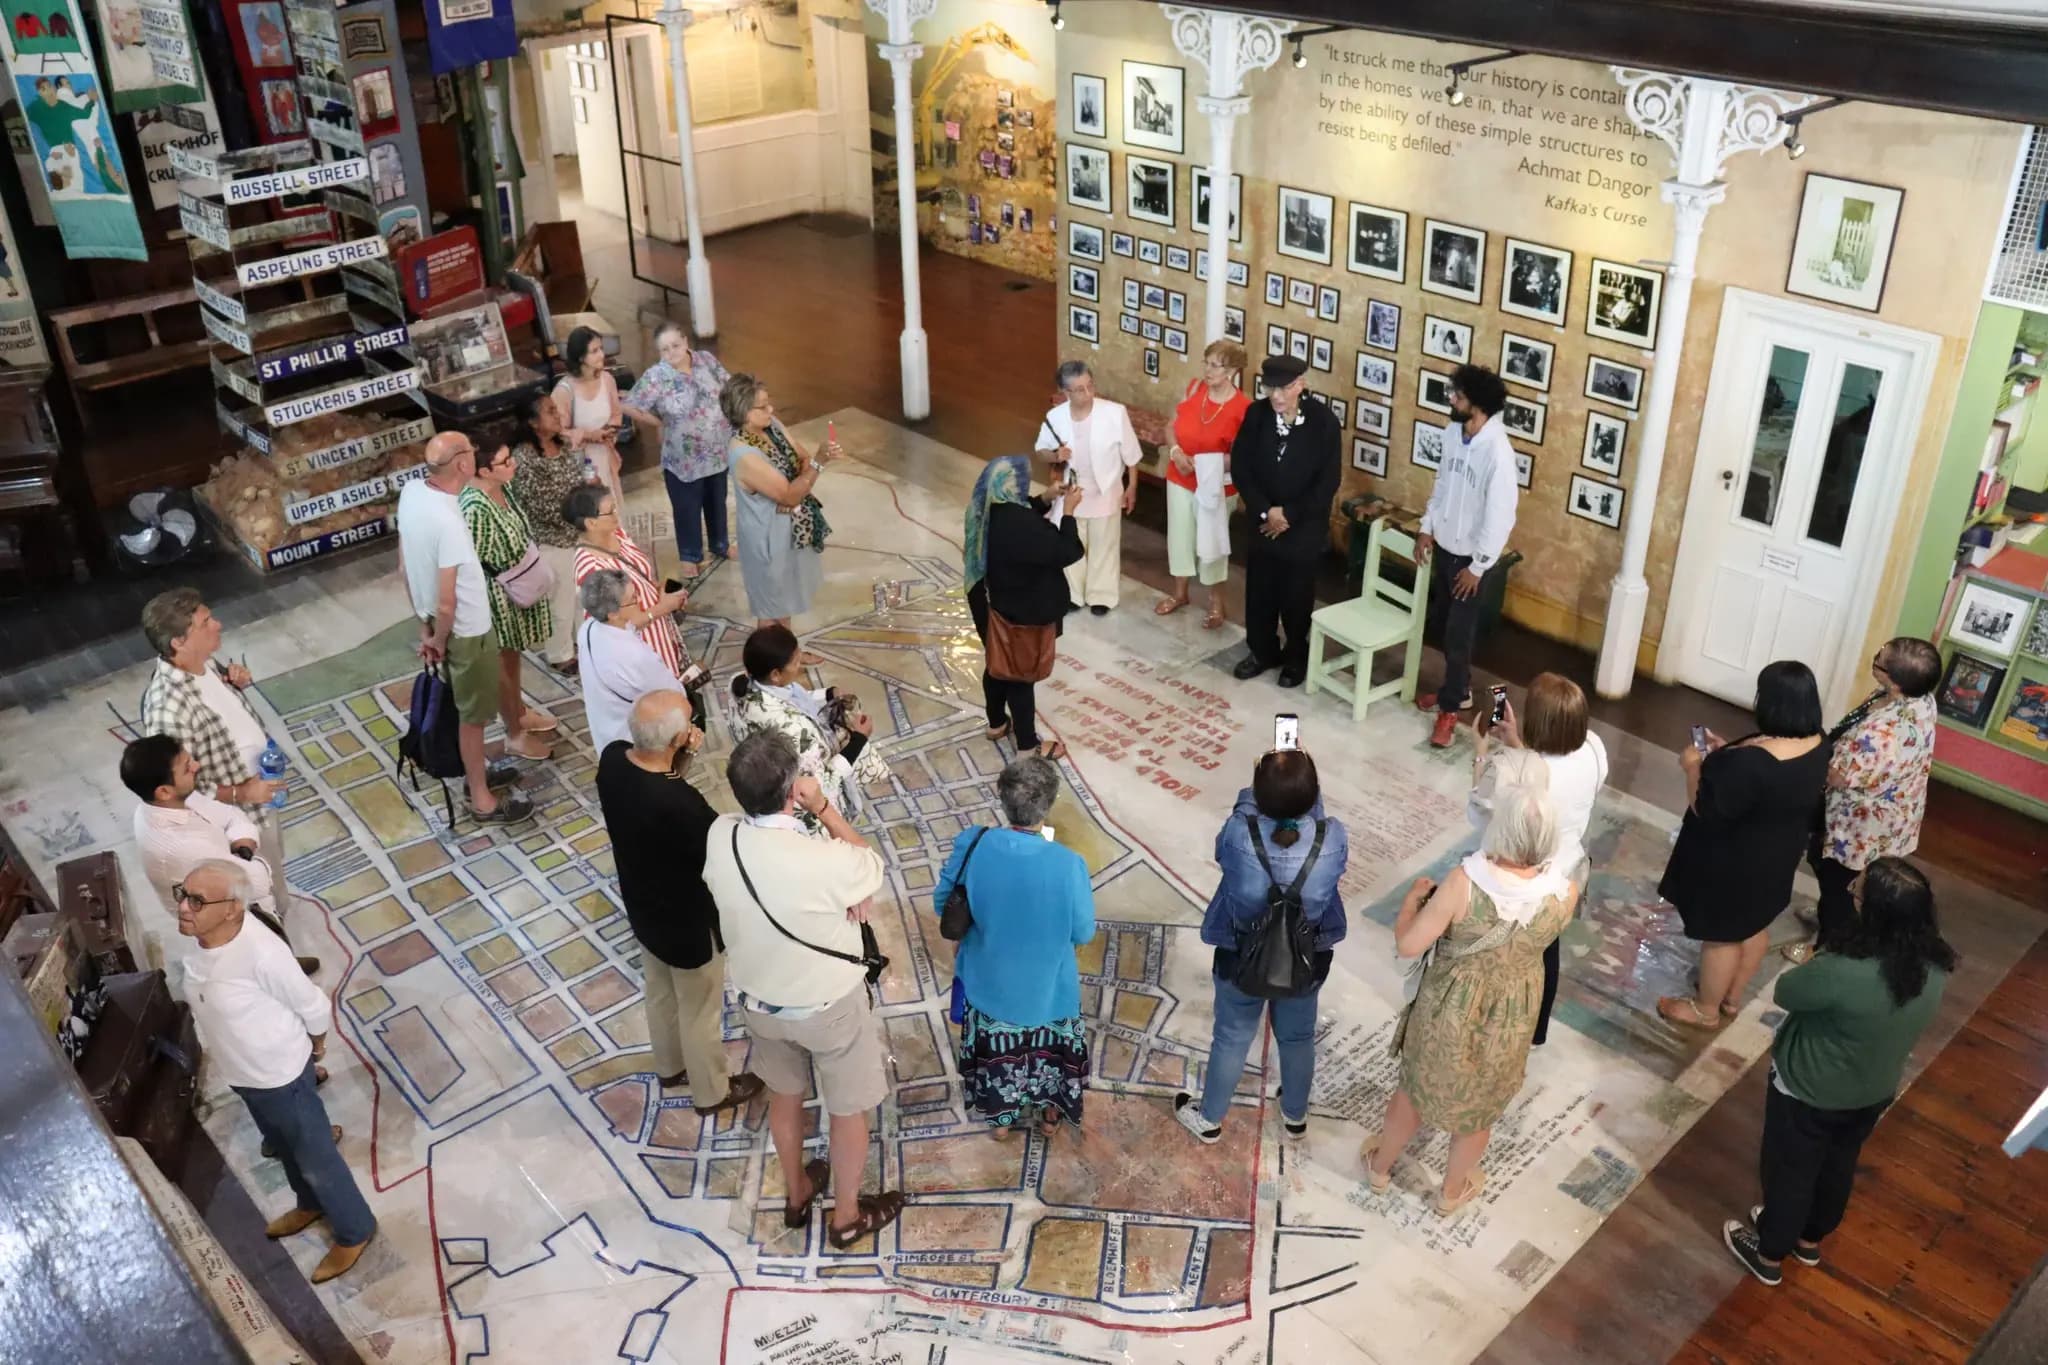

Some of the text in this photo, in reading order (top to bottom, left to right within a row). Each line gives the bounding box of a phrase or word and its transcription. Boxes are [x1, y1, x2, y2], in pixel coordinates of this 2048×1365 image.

[1344, 51, 1387, 69] struck
[1392, 59, 1415, 72] me
[1420, 59, 1449, 78] that
[1492, 69, 1548, 98] history
[1552, 80, 1564, 97] is
[1320, 70, 1333, 84] in
[1338, 72, 1360, 89] the
[1364, 75, 1413, 98] homes
[1420, 88, 1443, 103] we
[1502, 99, 1534, 119] that
[1541, 109, 1566, 124] we
[1571, 115, 1598, 130] are
[1318, 120, 1355, 139] resist
[1360, 127, 1397, 151] being
[1319, 93, 1648, 167] by the ability of these simple structures to
[230, 163, 361, 200] RUSSELL STREET
[1517, 157, 1652, 199] Achmat Dangor
[1545, 194, 1648, 227] Kafka's Curse
[247, 241, 380, 282] ASPELING STREET
[262, 328, 404, 378] ST PHILLIP STREET
[273, 373, 413, 422] STUCKERIS STREET
[307, 443, 365, 469] VINCENT
[373, 424, 424, 450] STREET
[291, 466, 429, 520] UPPER ASHLEY STRE
[272, 521, 381, 566] MOUNT STREET
[1190, 1255, 1202, 1288] KENT
[932, 1286, 1032, 1307] CANTERBURY
[754, 1314, 818, 1348] MUEZZIN
